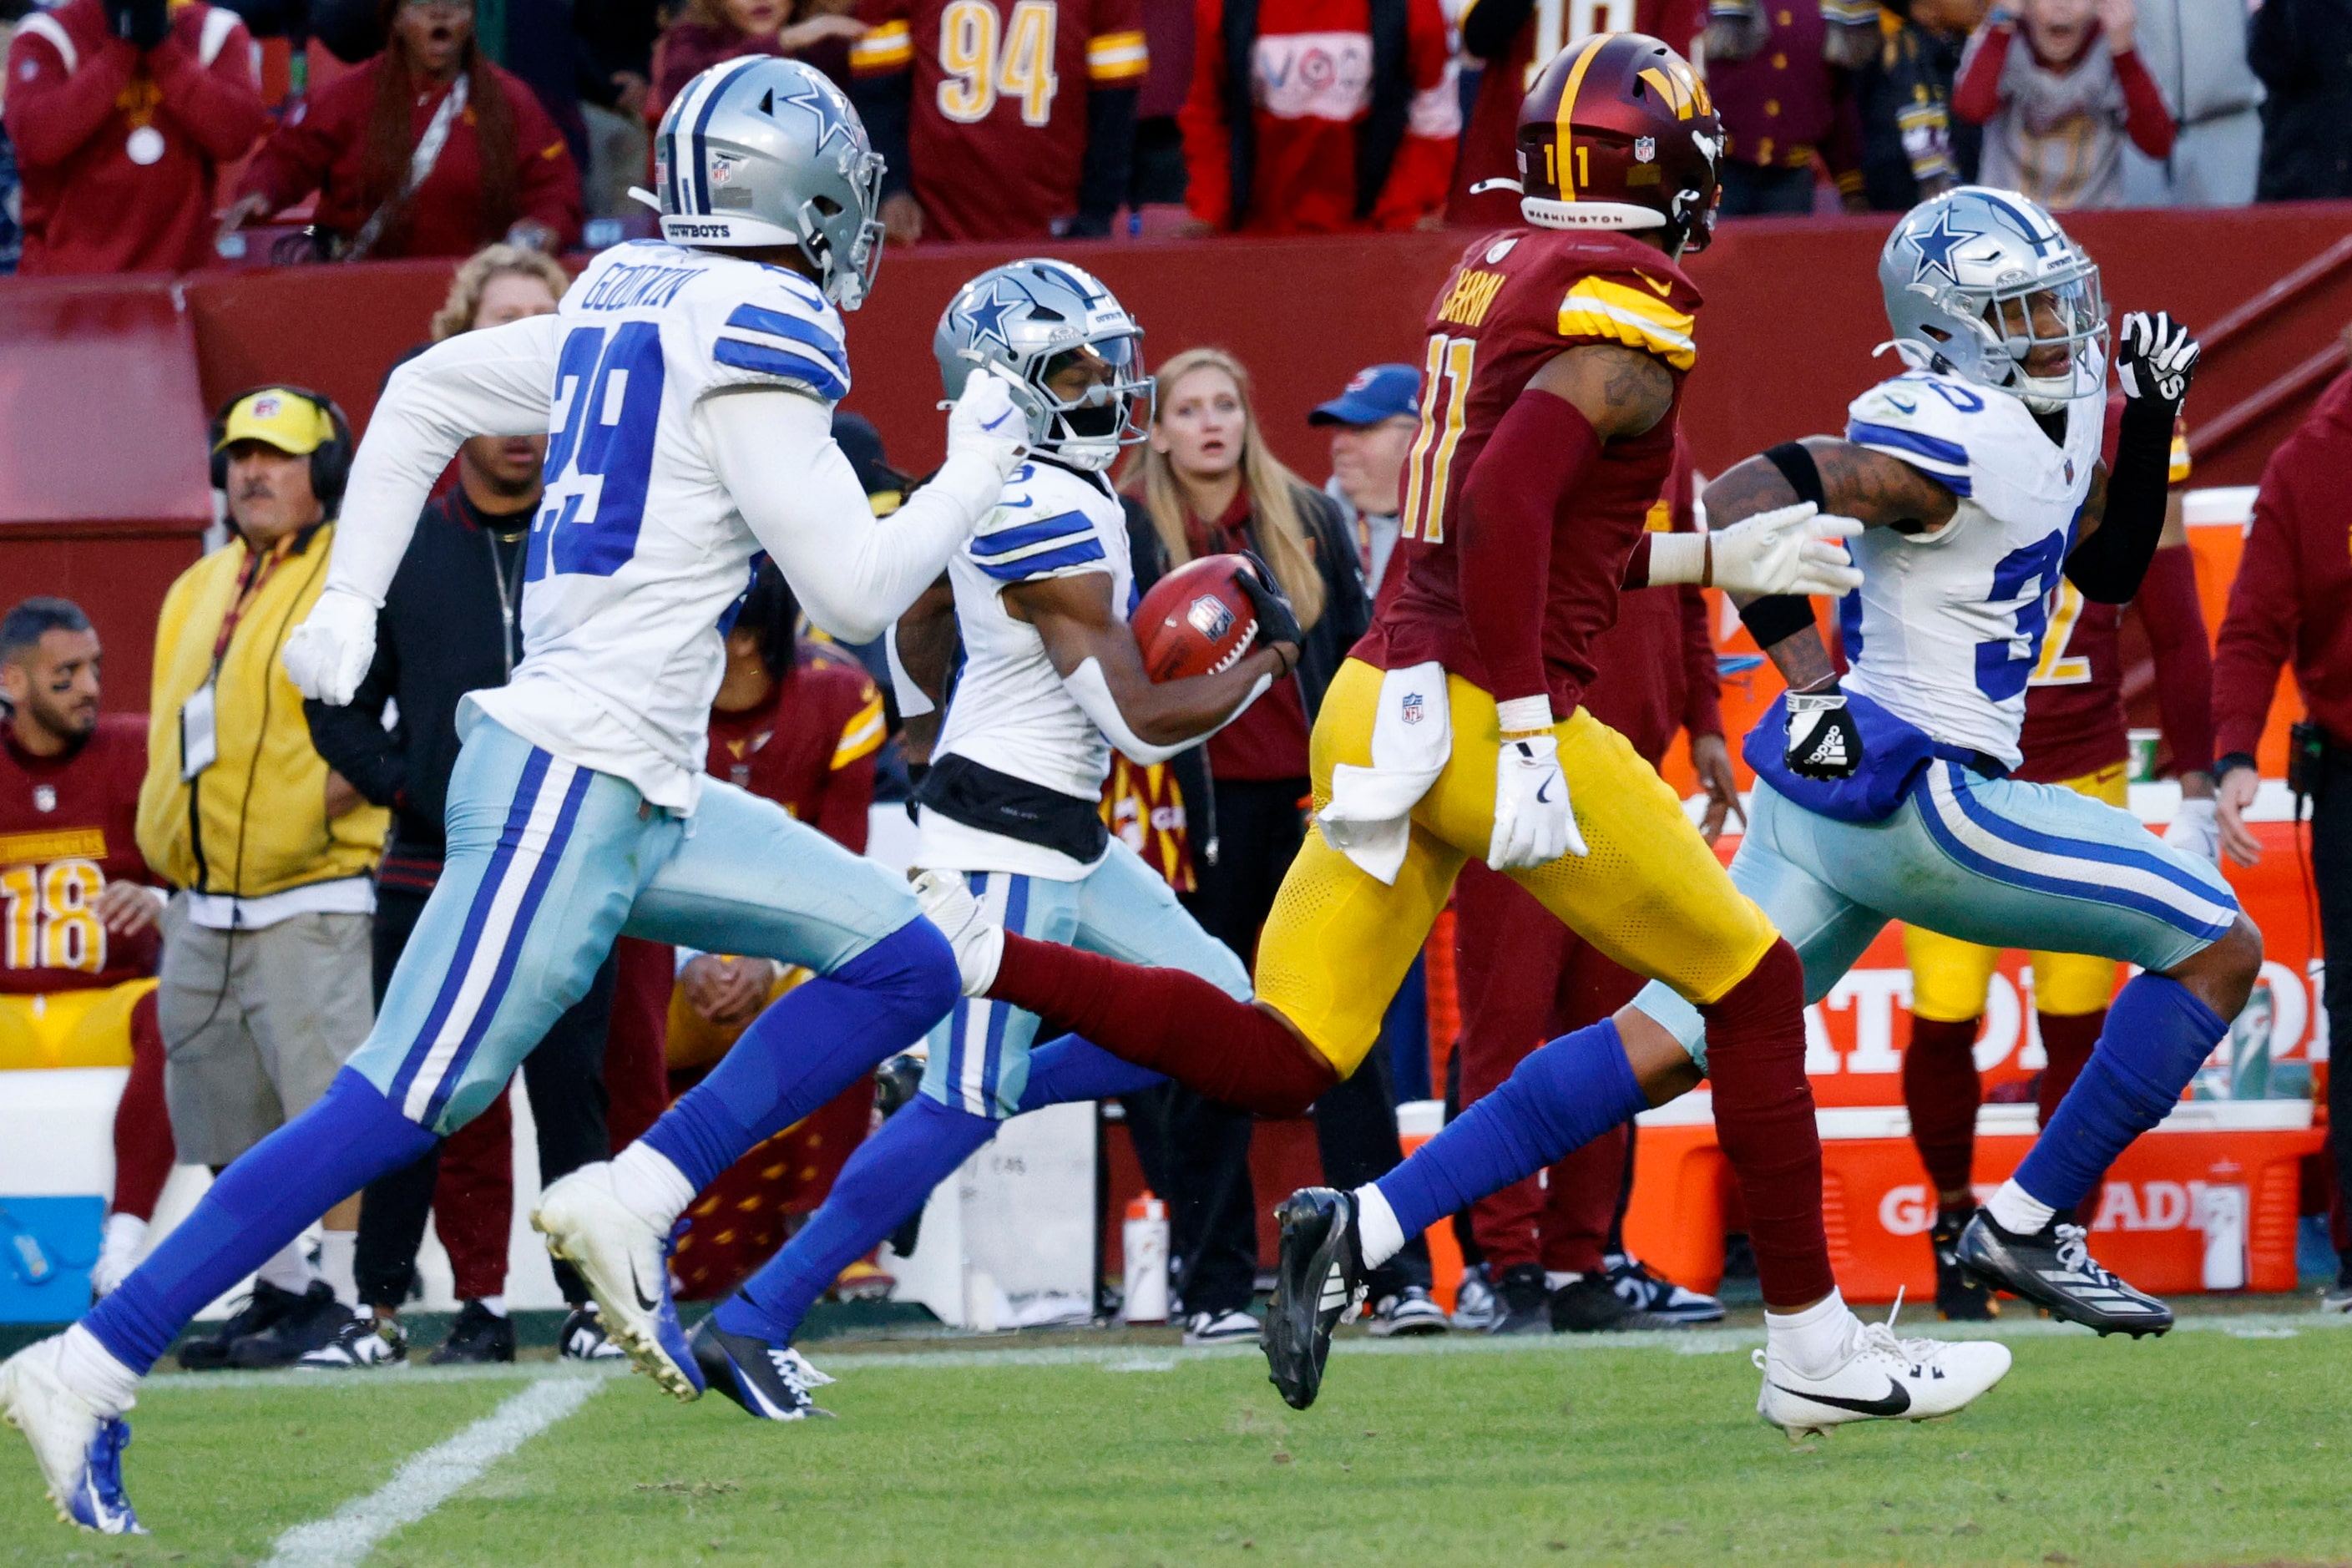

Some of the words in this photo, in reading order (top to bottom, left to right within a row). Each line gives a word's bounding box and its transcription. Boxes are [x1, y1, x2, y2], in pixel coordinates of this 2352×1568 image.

[936, 0, 1059, 127] 94
[1528, 210, 1623, 224] WASHINGTON
[523, 321, 666, 583] 29
[1401, 333, 1477, 544] 11
[1404, 706, 1424, 722] NFL
[0, 857, 107, 975] 18
